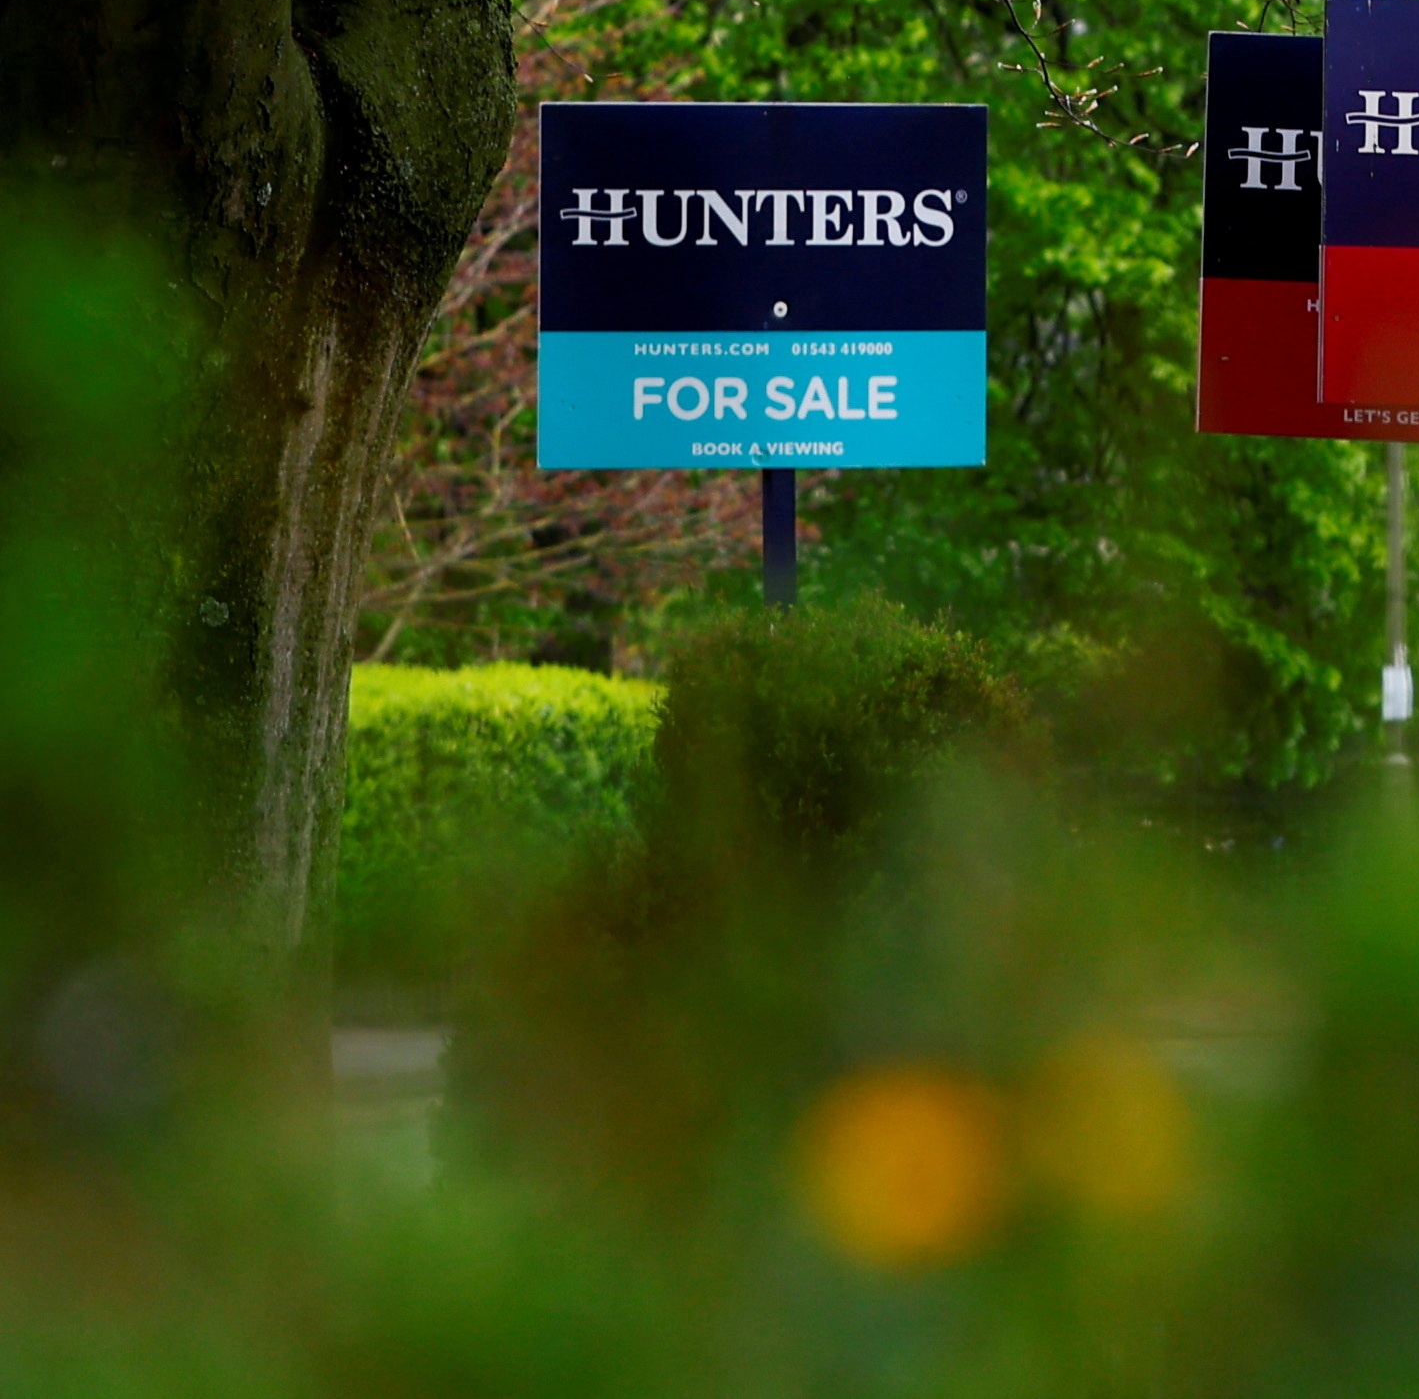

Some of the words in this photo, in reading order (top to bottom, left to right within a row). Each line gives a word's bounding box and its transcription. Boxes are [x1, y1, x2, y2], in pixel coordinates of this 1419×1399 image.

[560, 188, 955, 247] HUNTERS
[634, 343, 770, 355] HUNTERS.COM
[791, 342, 836, 355] 01543
[840, 342, 893, 355] 419000
[633, 376, 748, 421] FOR
[765, 375, 898, 421] SALE
[1343, 409, 1391, 424] LET'S
[691, 442, 743, 456] BOOK
[748, 442, 761, 456] A
[766, 442, 844, 456] VIEWING
